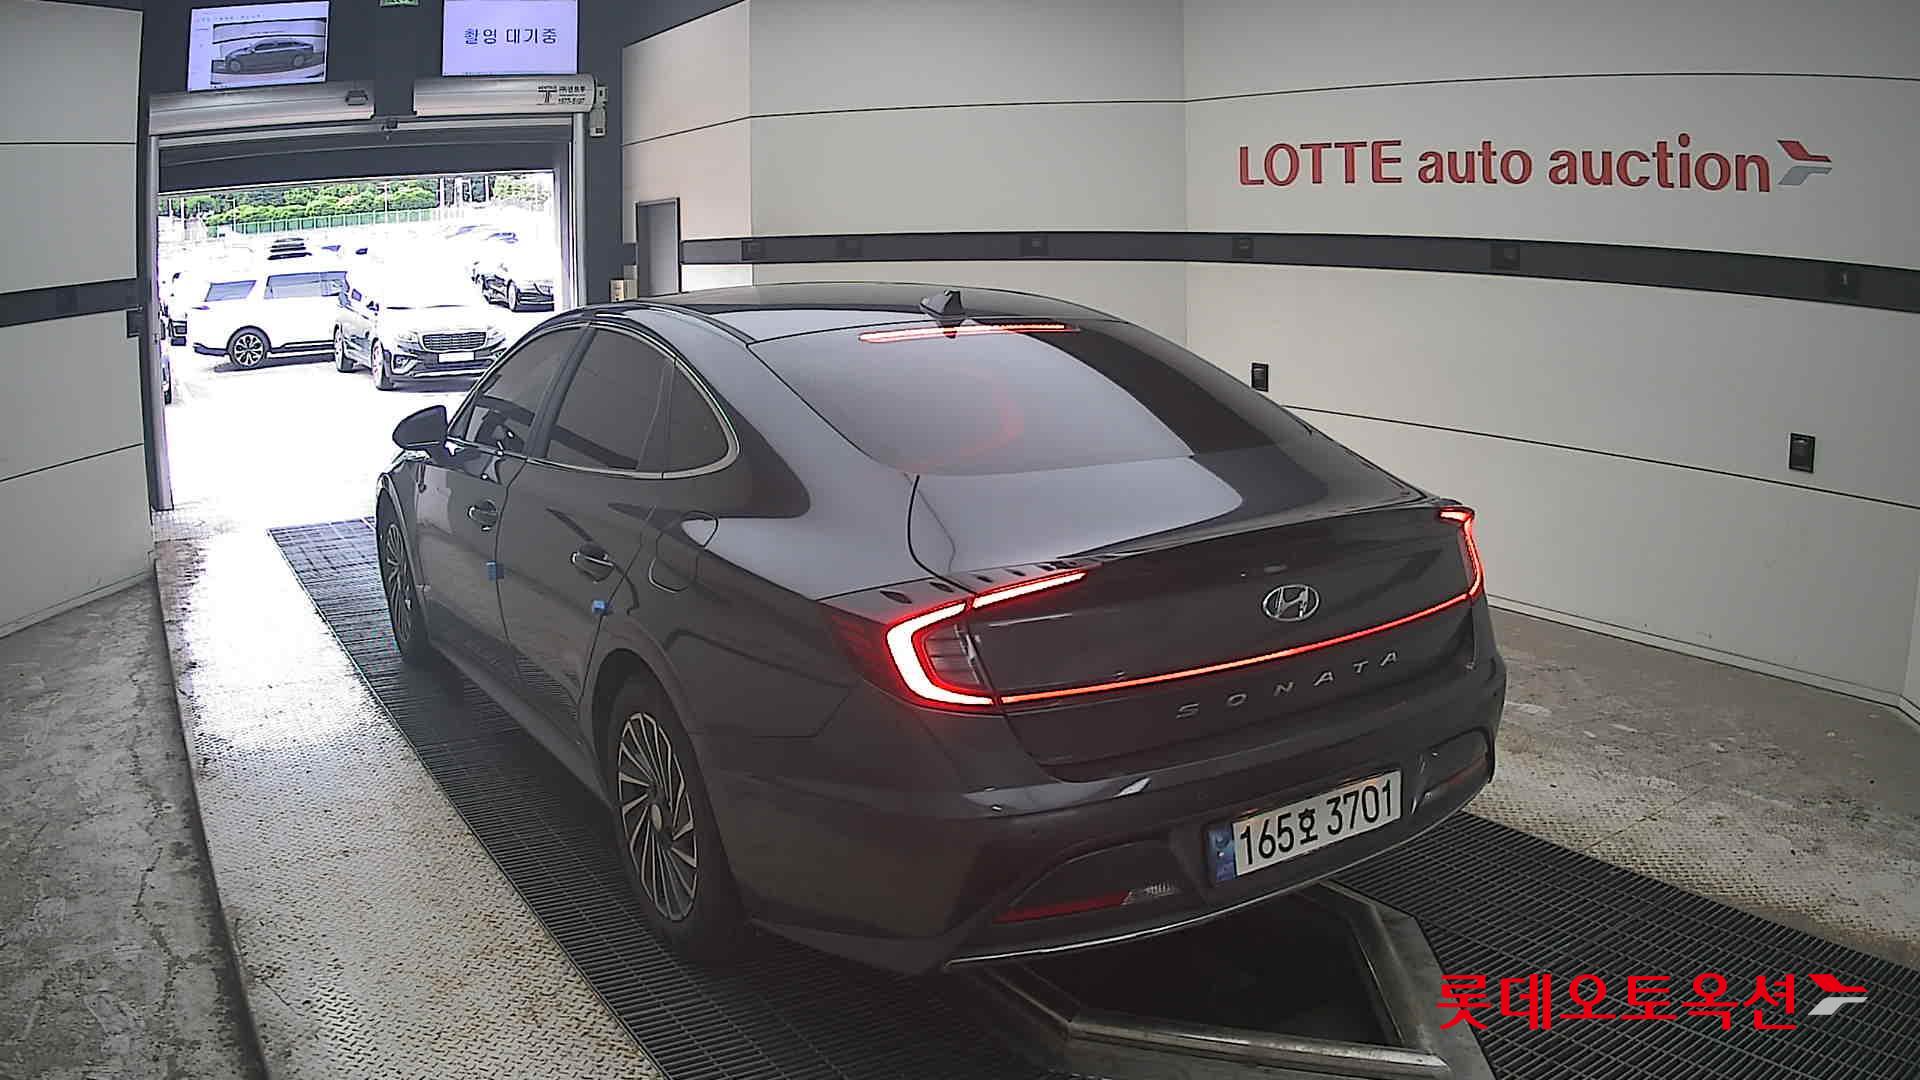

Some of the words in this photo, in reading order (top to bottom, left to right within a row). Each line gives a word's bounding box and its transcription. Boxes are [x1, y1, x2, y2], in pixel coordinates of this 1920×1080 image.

[506, 28, 558, 45] 대기중
[1239, 140, 1401, 186] LOTTE
[1418, 140, 1533, 185] auto
[1548, 134, 1771, 193] auction
[1175, 651, 1398, 719] SONATA
[1240, 807, 1318, 864] 165호
[1326, 779, 1392, 835] 3701
